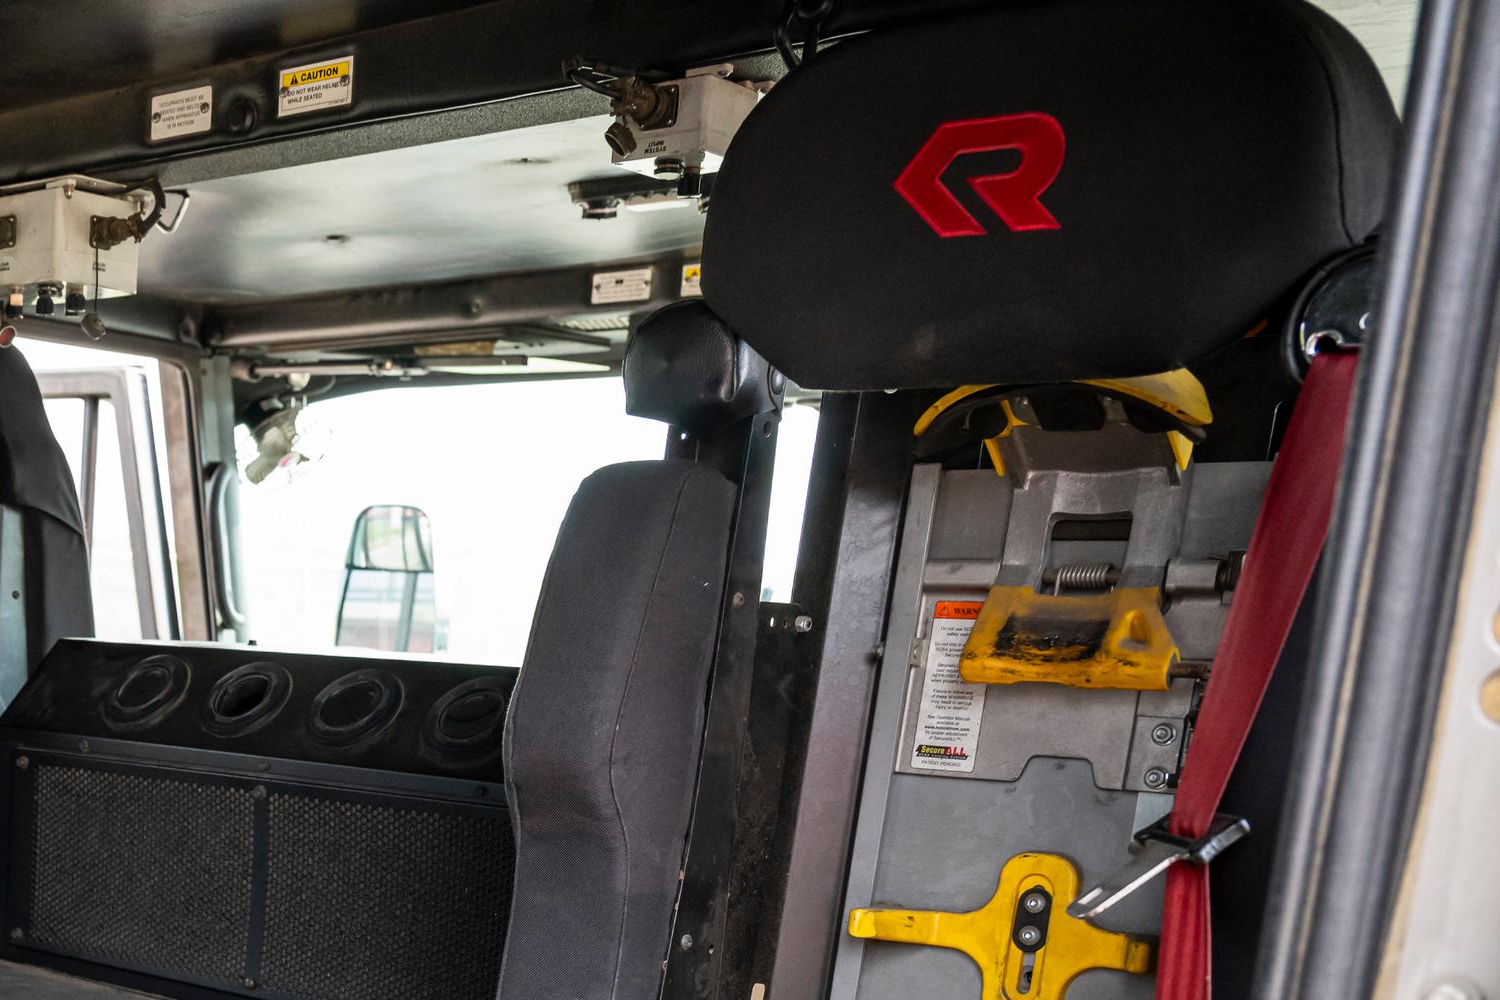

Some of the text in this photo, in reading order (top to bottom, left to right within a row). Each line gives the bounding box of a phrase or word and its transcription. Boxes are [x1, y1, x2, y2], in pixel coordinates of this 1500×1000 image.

[300, 66, 339, 82] CAUTION
[287, 92, 323, 104] WHILE SEATED
[644, 145, 667, 154] SYSTEM
